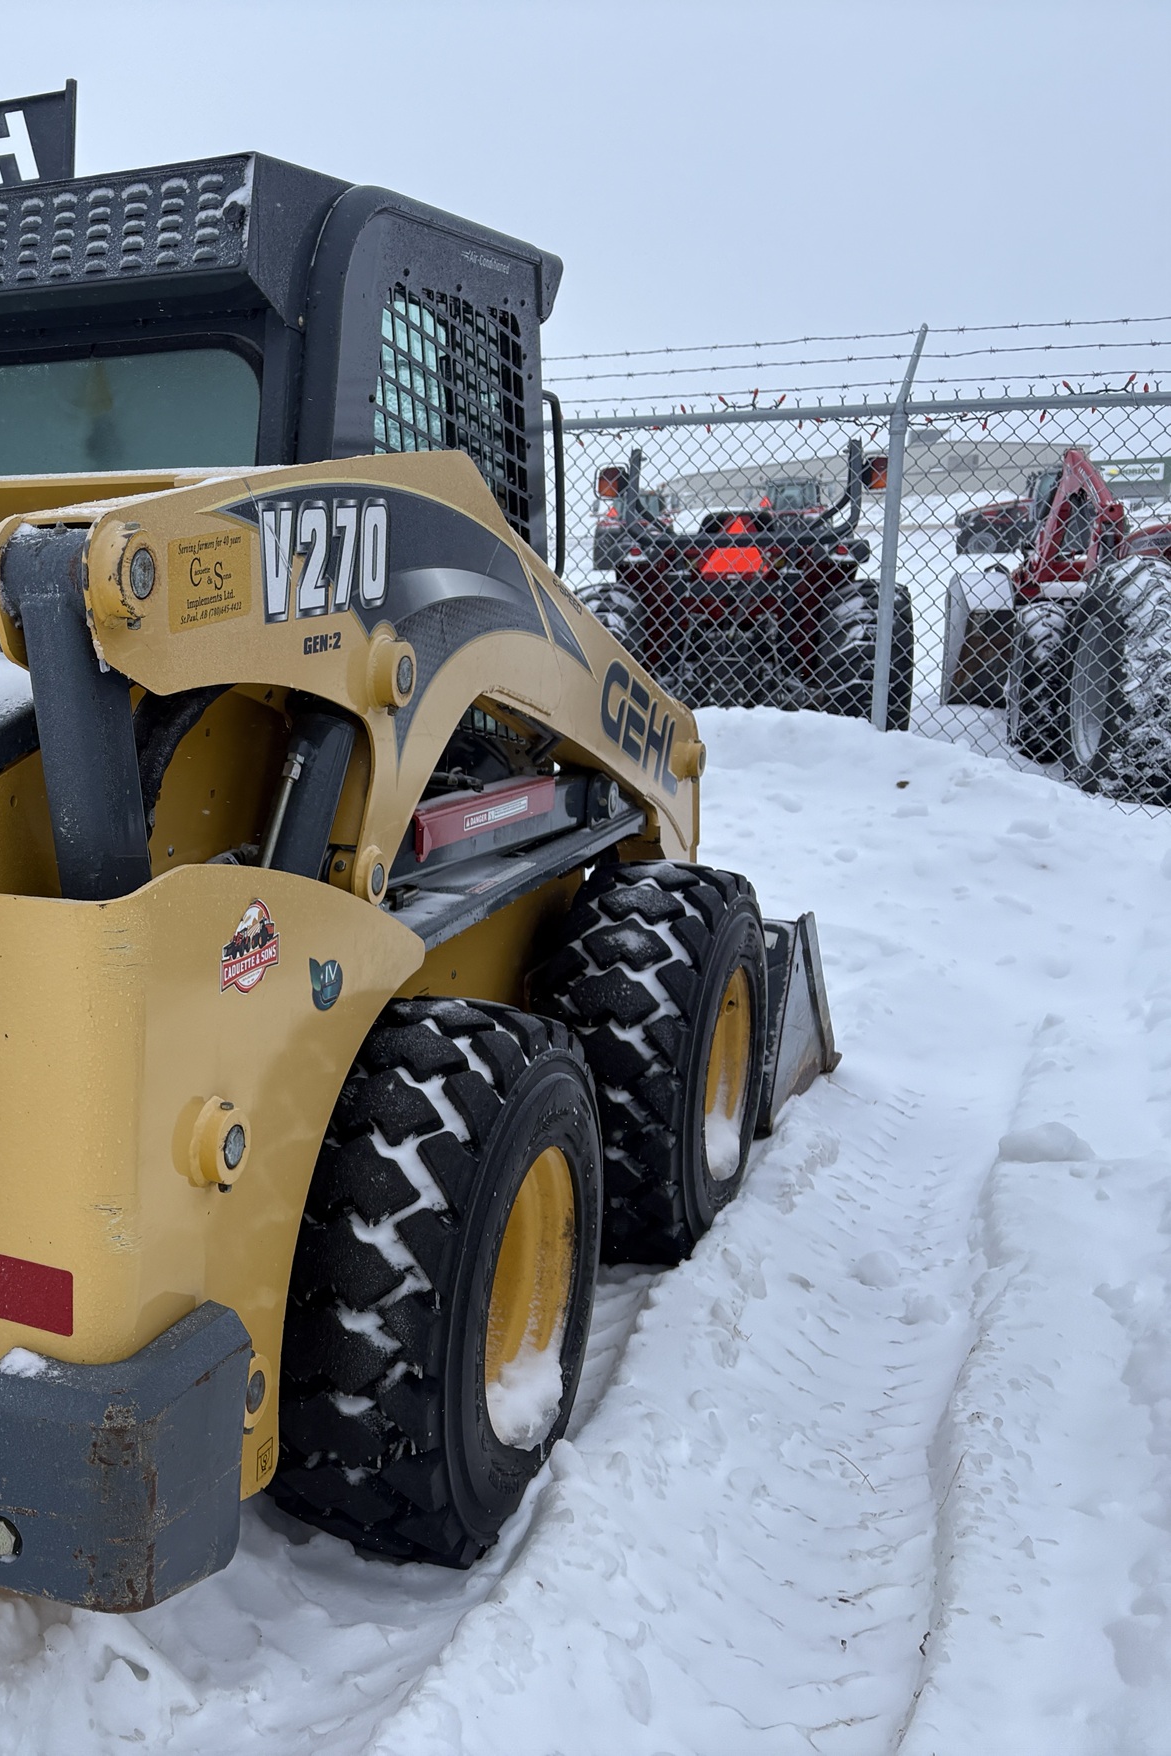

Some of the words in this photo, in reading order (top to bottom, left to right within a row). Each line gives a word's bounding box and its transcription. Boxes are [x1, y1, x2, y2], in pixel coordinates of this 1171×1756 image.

[178, 543, 197, 555] Serving
[197, 540, 215, 554] farmers
[223, 535, 230, 545] 40
[230, 536, 241, 547] years
[258, 497, 391, 624] V270
[207, 576, 213, 585] &
[214, 561, 232, 590] Sons
[187, 593, 223, 610] Implements
[224, 589, 235, 600] Ltd.
[303, 631, 341, 655] GEN:2
[600, 657, 678, 796] GEHL
[470, 813, 488, 826] DANGER
[256, 954, 261, 964] &
[261, 944, 277, 962] SONS
